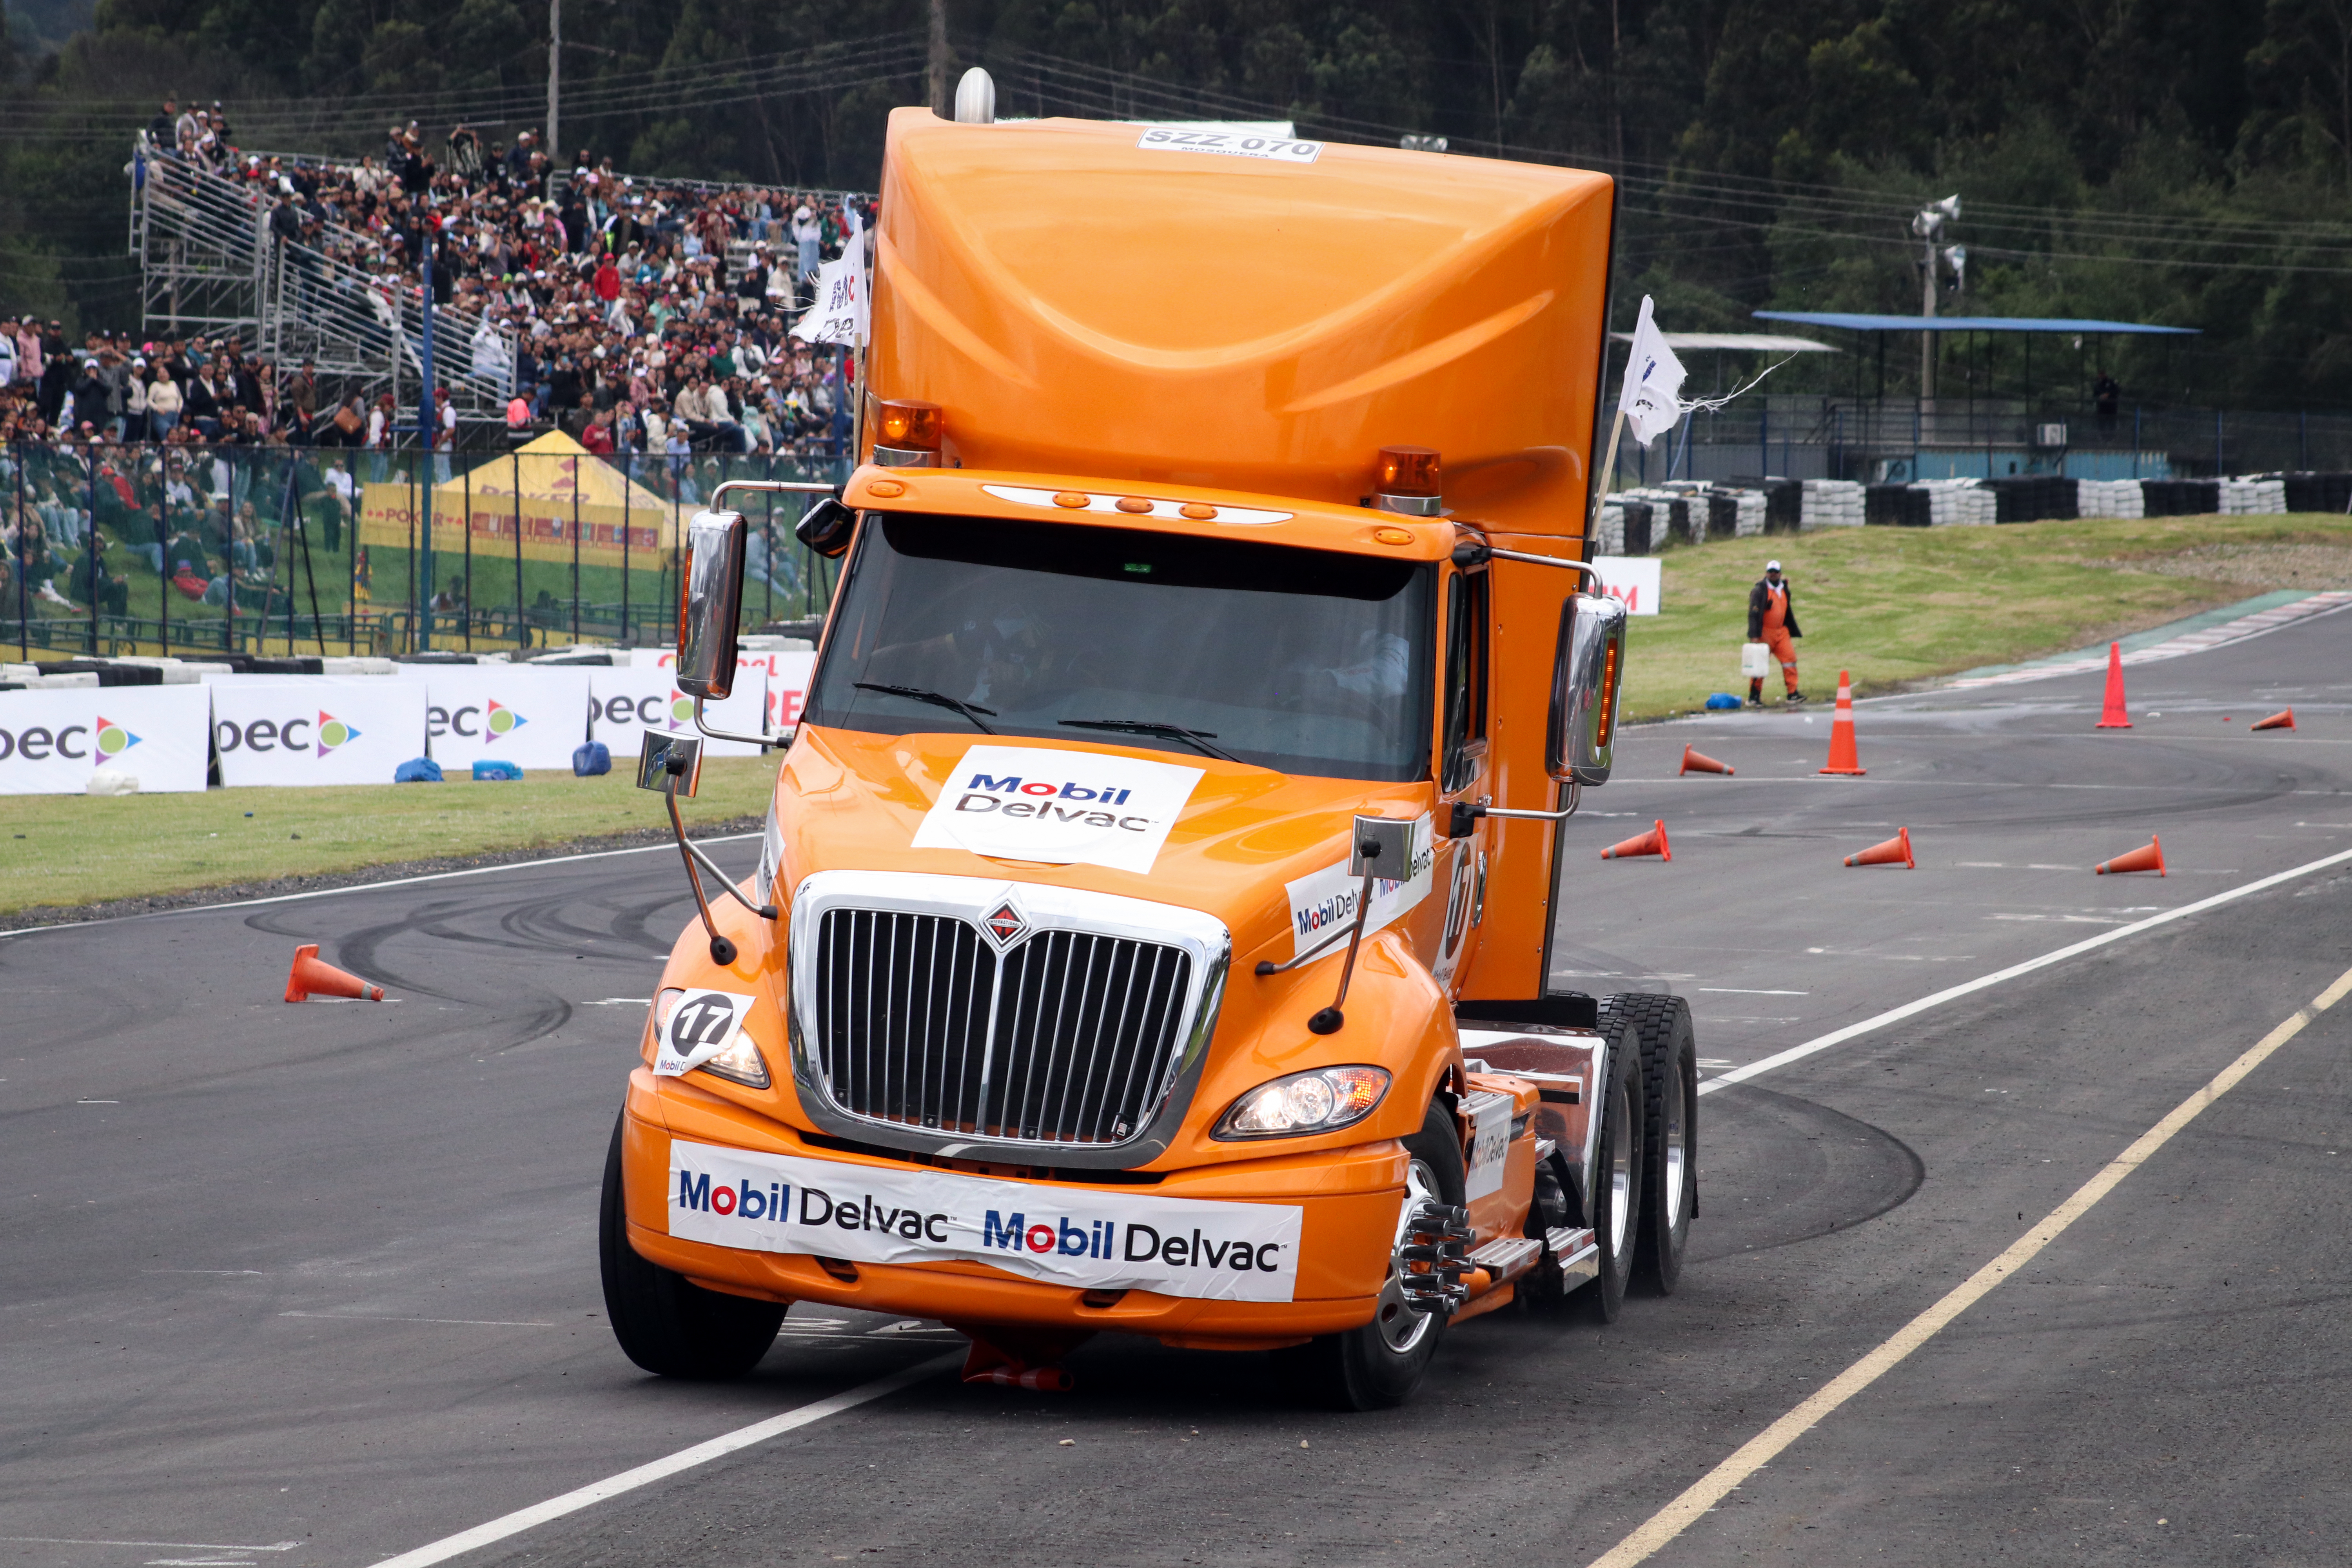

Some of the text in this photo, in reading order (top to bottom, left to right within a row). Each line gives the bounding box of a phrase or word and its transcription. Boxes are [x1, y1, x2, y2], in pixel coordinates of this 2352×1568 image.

[1145, 131, 1317, 155] SZZ 070
[1181, 147, 1269, 158] MOSQUERA
[386, 507, 444, 526] POKR
[967, 774, 1132, 805] Mobil
[1298, 898, 1334, 935] Mobil
[1448, 864, 1472, 938] 17
[679, 1003, 733, 1042] 17
[659, 1060, 681, 1071] Mobil
[679, 1170, 790, 1222] Mobil
[984, 1210, 1114, 1259] Mobil
